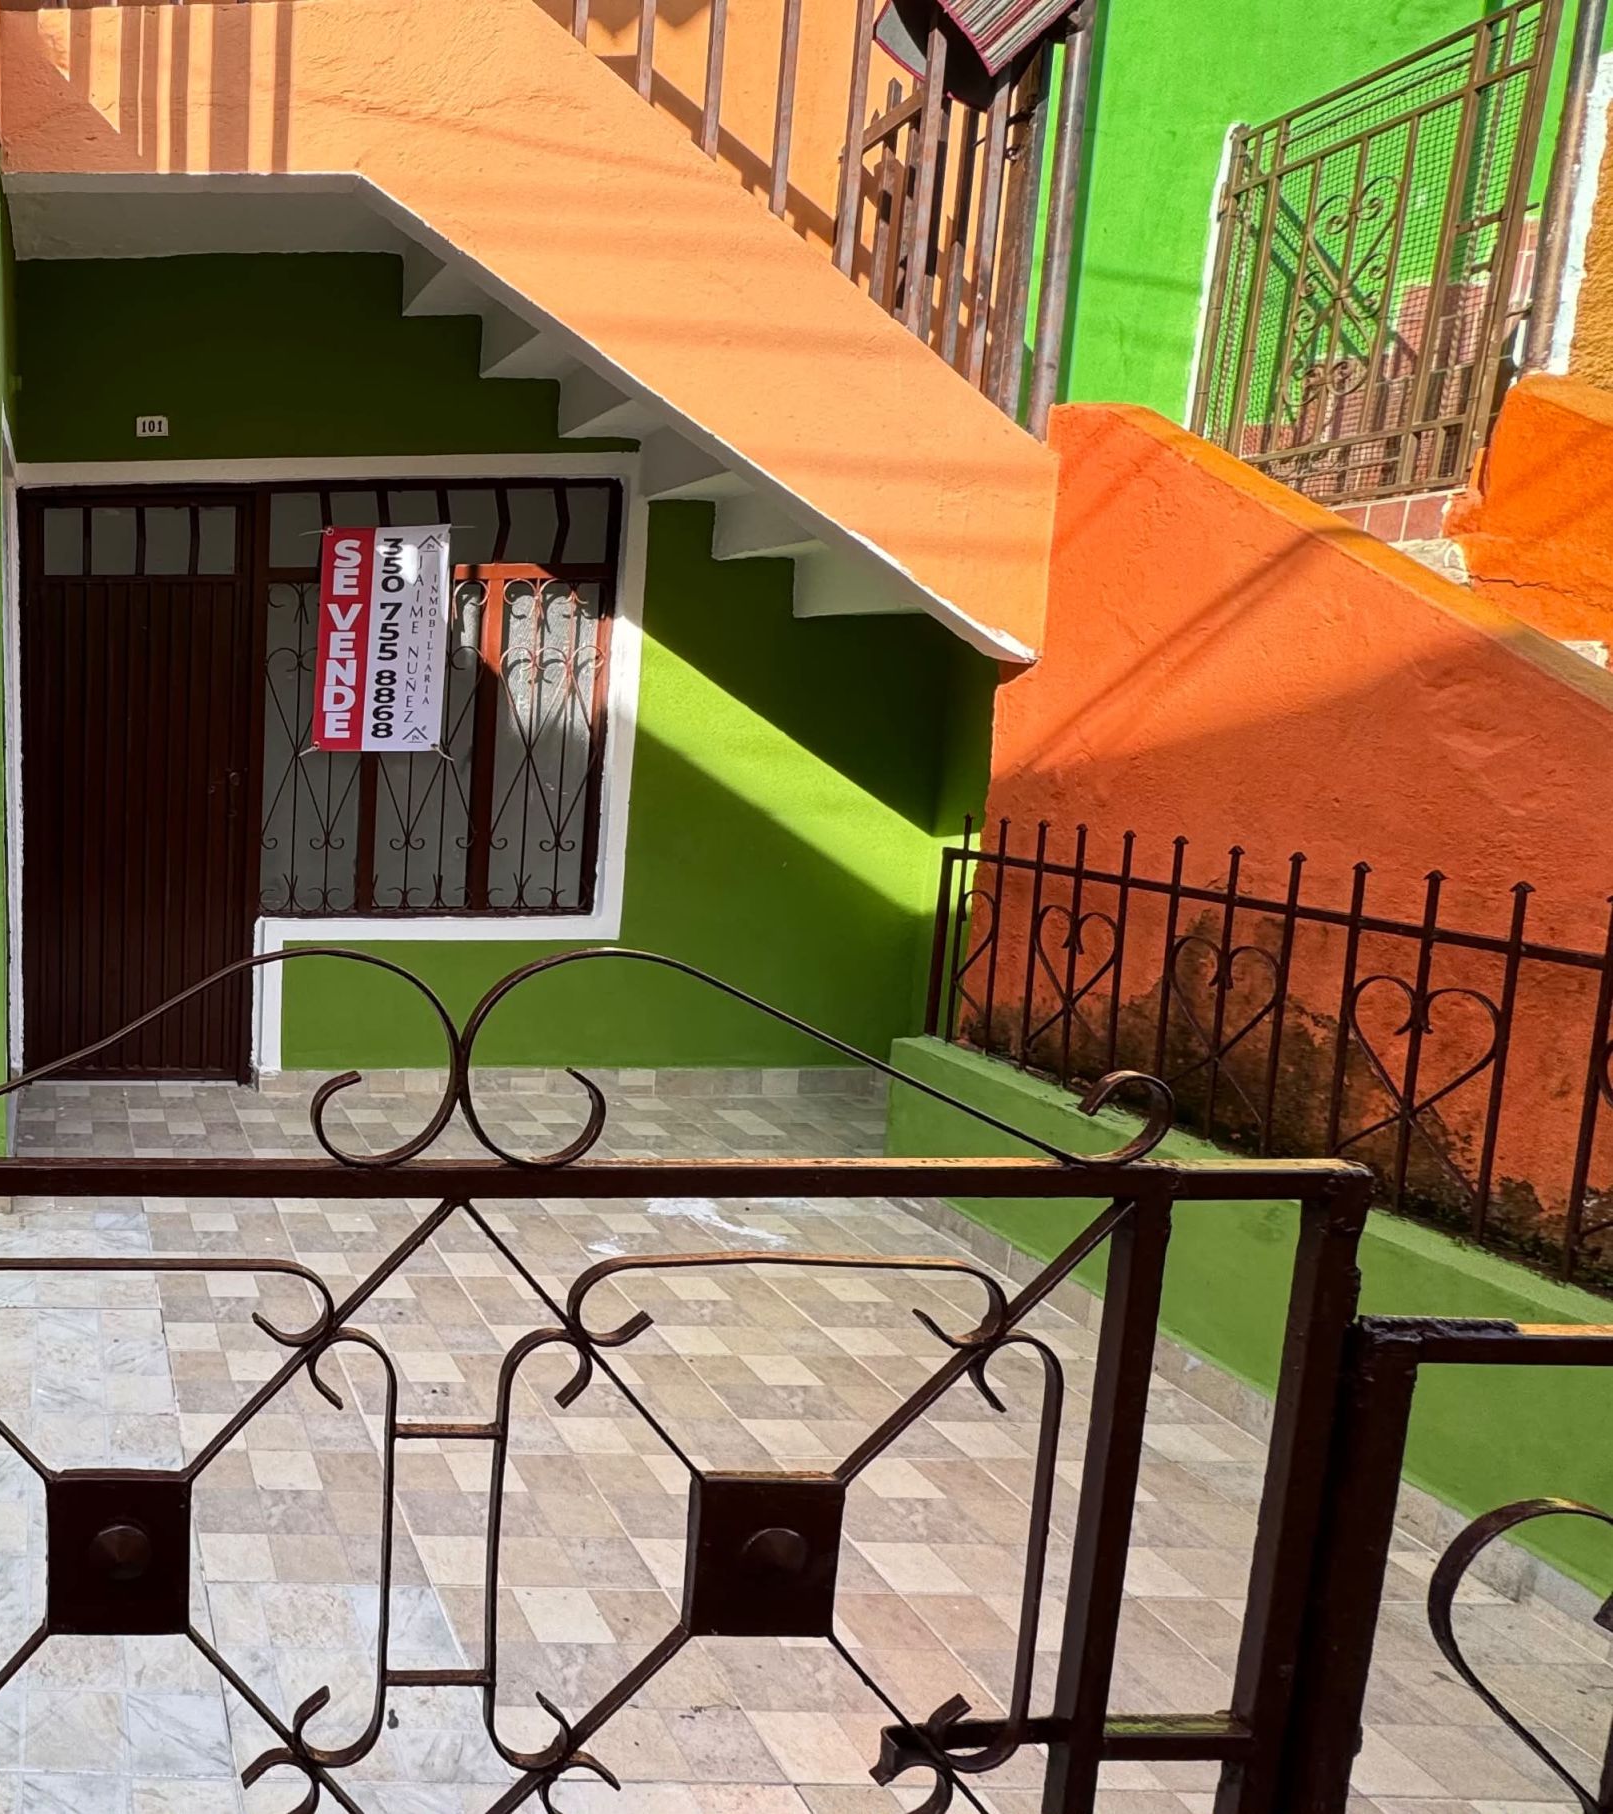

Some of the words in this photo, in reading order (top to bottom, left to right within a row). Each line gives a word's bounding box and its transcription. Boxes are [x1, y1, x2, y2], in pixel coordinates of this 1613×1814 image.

[142, 420, 163, 433] 101
[333, 539, 362, 596] SE
[381, 537, 405, 593] 350
[409, 555, 424, 634] JAIME
[377, 602, 403, 661] 755
[422, 574, 439, 705] INMOBILIARIA
[322, 603, 363, 738] VENDE
[371, 669, 397, 739] 8868
[403, 647, 420, 723] NUÑEZ
